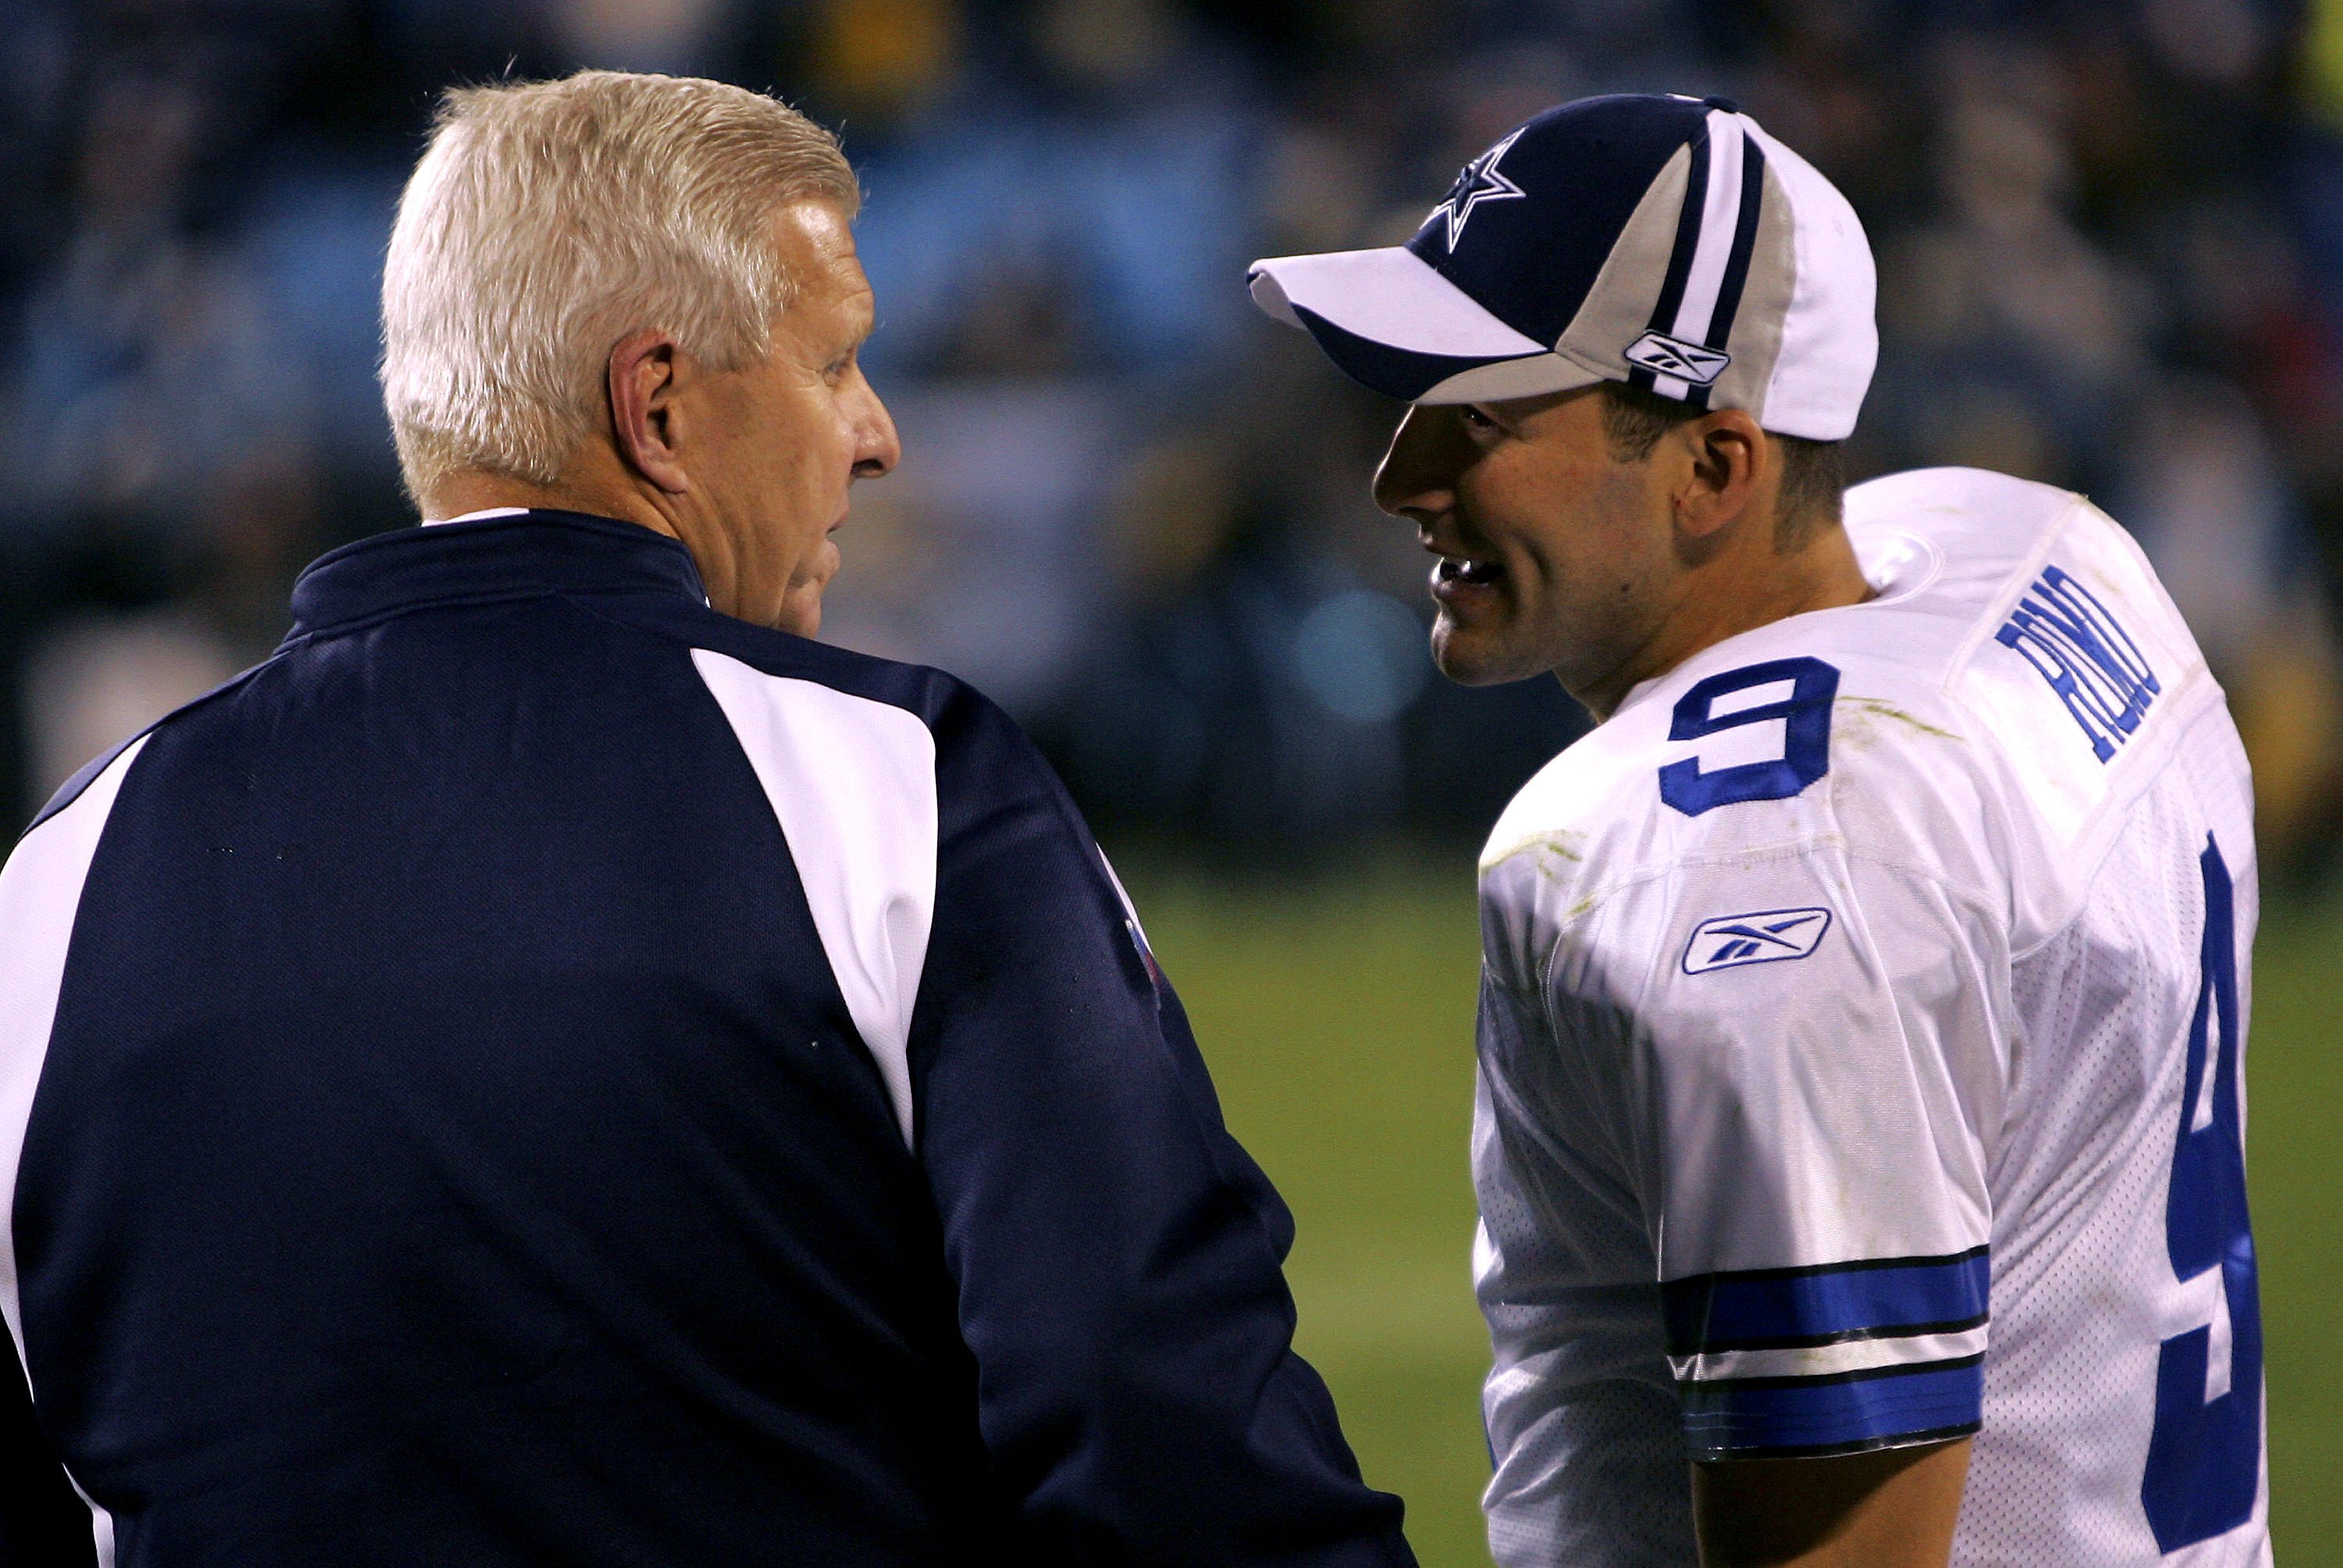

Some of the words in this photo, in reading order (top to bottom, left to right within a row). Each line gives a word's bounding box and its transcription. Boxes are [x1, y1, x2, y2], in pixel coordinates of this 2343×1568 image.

[1658, 656, 1842, 818] 9
[1995, 565, 2161, 765] ROMO
[2141, 830, 2263, 1556] 9
